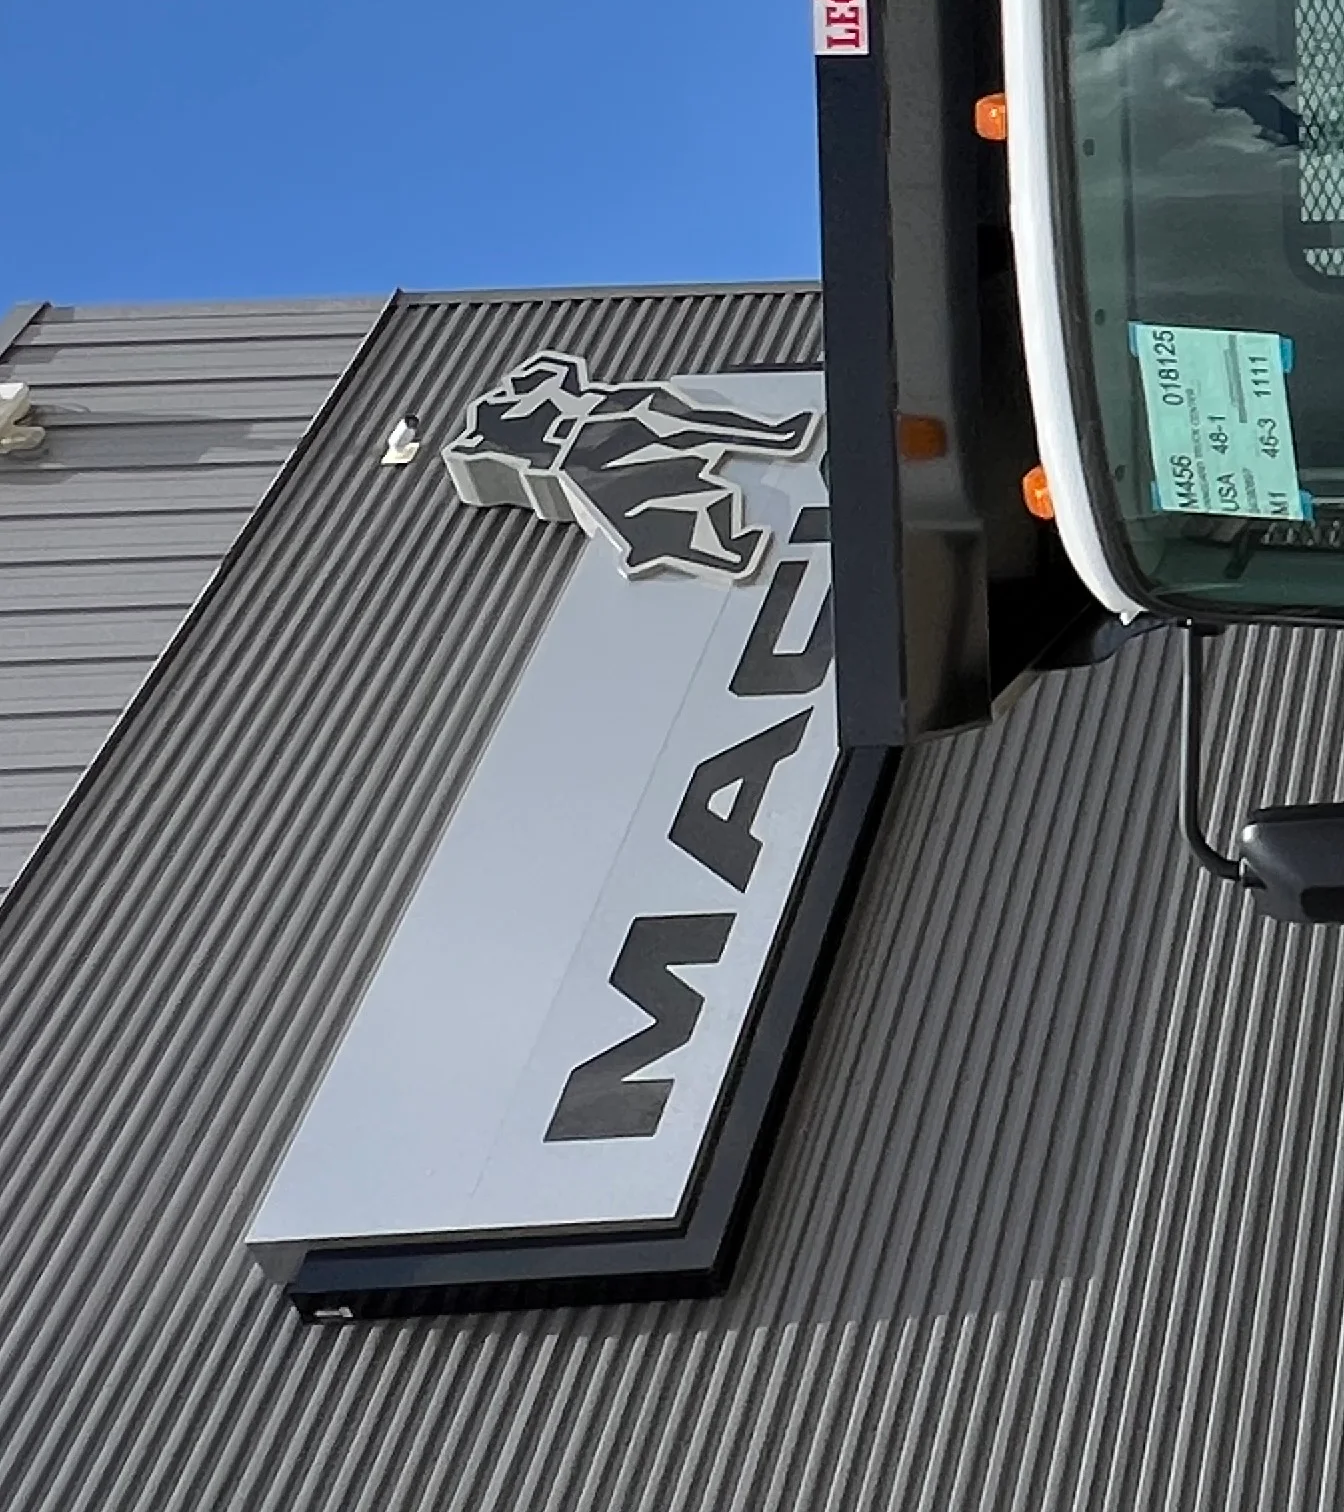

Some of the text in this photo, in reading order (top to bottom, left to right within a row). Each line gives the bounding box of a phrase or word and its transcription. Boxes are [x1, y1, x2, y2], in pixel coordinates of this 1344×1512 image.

[1152, 330, 1199, 509] M456 018125
[1207, 414, 1240, 512] USA 48-1
[1248, 355, 1289, 515] M1 46-3 1111
[543, 443, 834, 1141] MAC
